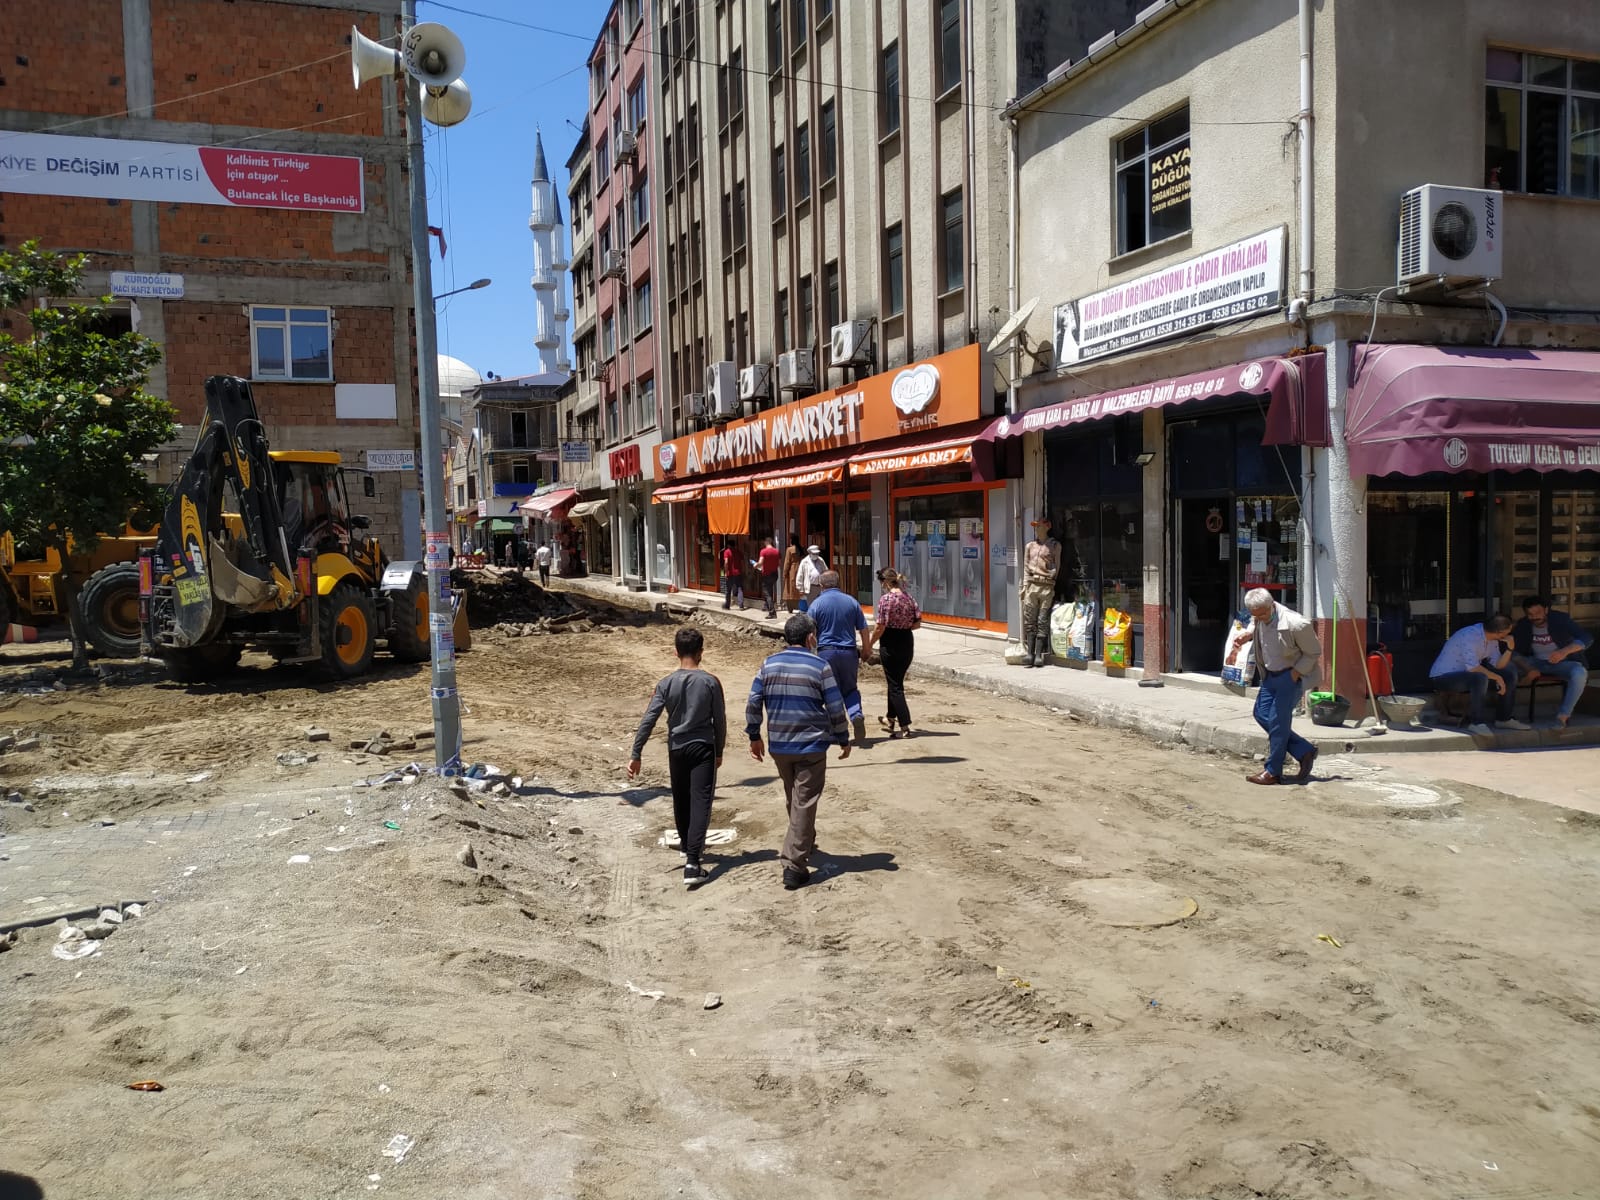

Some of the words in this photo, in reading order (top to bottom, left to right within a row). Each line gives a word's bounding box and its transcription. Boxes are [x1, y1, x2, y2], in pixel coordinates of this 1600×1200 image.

[47, 157, 119, 176] DEĞİŞİM
[128, 164, 199, 181] PARTİSİ
[227, 154, 270, 167] Kalbimiz
[272, 157, 310, 172] Türkiye
[1152, 147, 1191, 174] KAYA
[227, 168, 244, 181] için
[248, 172, 279, 184] atıyor
[1152, 165, 1192, 190] DÜĞÜN
[227, 188, 278, 201] Bulancak
[280, 189, 300, 203] İlçe
[303, 193, 358, 207] Başkanlığı
[1484, 194, 1496, 239] arçelik
[113, 285, 130, 293] HACI
[131, 285, 151, 294] HAFIZ
[153, 286, 183, 295] MEYDANI
[124, 275, 171, 285] KURDOĞLU
[1084, 300, 1099, 322] KAYA
[1101, 289, 1123, 317] DÜĞÜN
[1125, 268, 1185, 308] ORGANİZASYONU
[1186, 266, 1192, 288] &
[1194, 256, 1219, 290] ÇADIR
[1084, 324, 1099, 341] DÜĞÜN
[1100, 321, 1113, 337] NİŞAN
[1113, 315, 1131, 332] SÜNNET
[1132, 312, 1138, 326] VE
[1173, 295, 1190, 316] ÇADIR
[1190, 293, 1198, 308] VE
[1198, 279, 1241, 305] ORGANİZASYON
[1242, 272, 1266, 293] YAPILIR
[1120, 334, 1139, 345] Hasan
[1140, 327, 1156, 340] KAYA
[1174, 318, 1186, 331] 314
[1187, 315, 1196, 327] 35
[1197, 312, 1206, 324] 91
[1231, 301, 1245, 314] 624
[1246, 298, 1256, 310] 62
[1258, 295, 1268, 307] 02
[1046, 408, 1061, 424] KARA
[1062, 409, 1070, 421] ve
[1070, 399, 1090, 419] DENİZ
[1091, 399, 1101, 414] AV
[1102, 385, 1154, 412] MALZEMELERİ
[701, 419, 767, 465] APAYDIN
[771, 391, 865, 450] MARKET
[864, 456, 908, 473] APAYDIN
[910, 448, 958, 467] MARKET
[1534, 444, 1562, 465] KARA
[1563, 450, 1576, 465] ve
[766, 476, 794, 488] APAYDIN
[796, 472, 824, 486] MARKET
